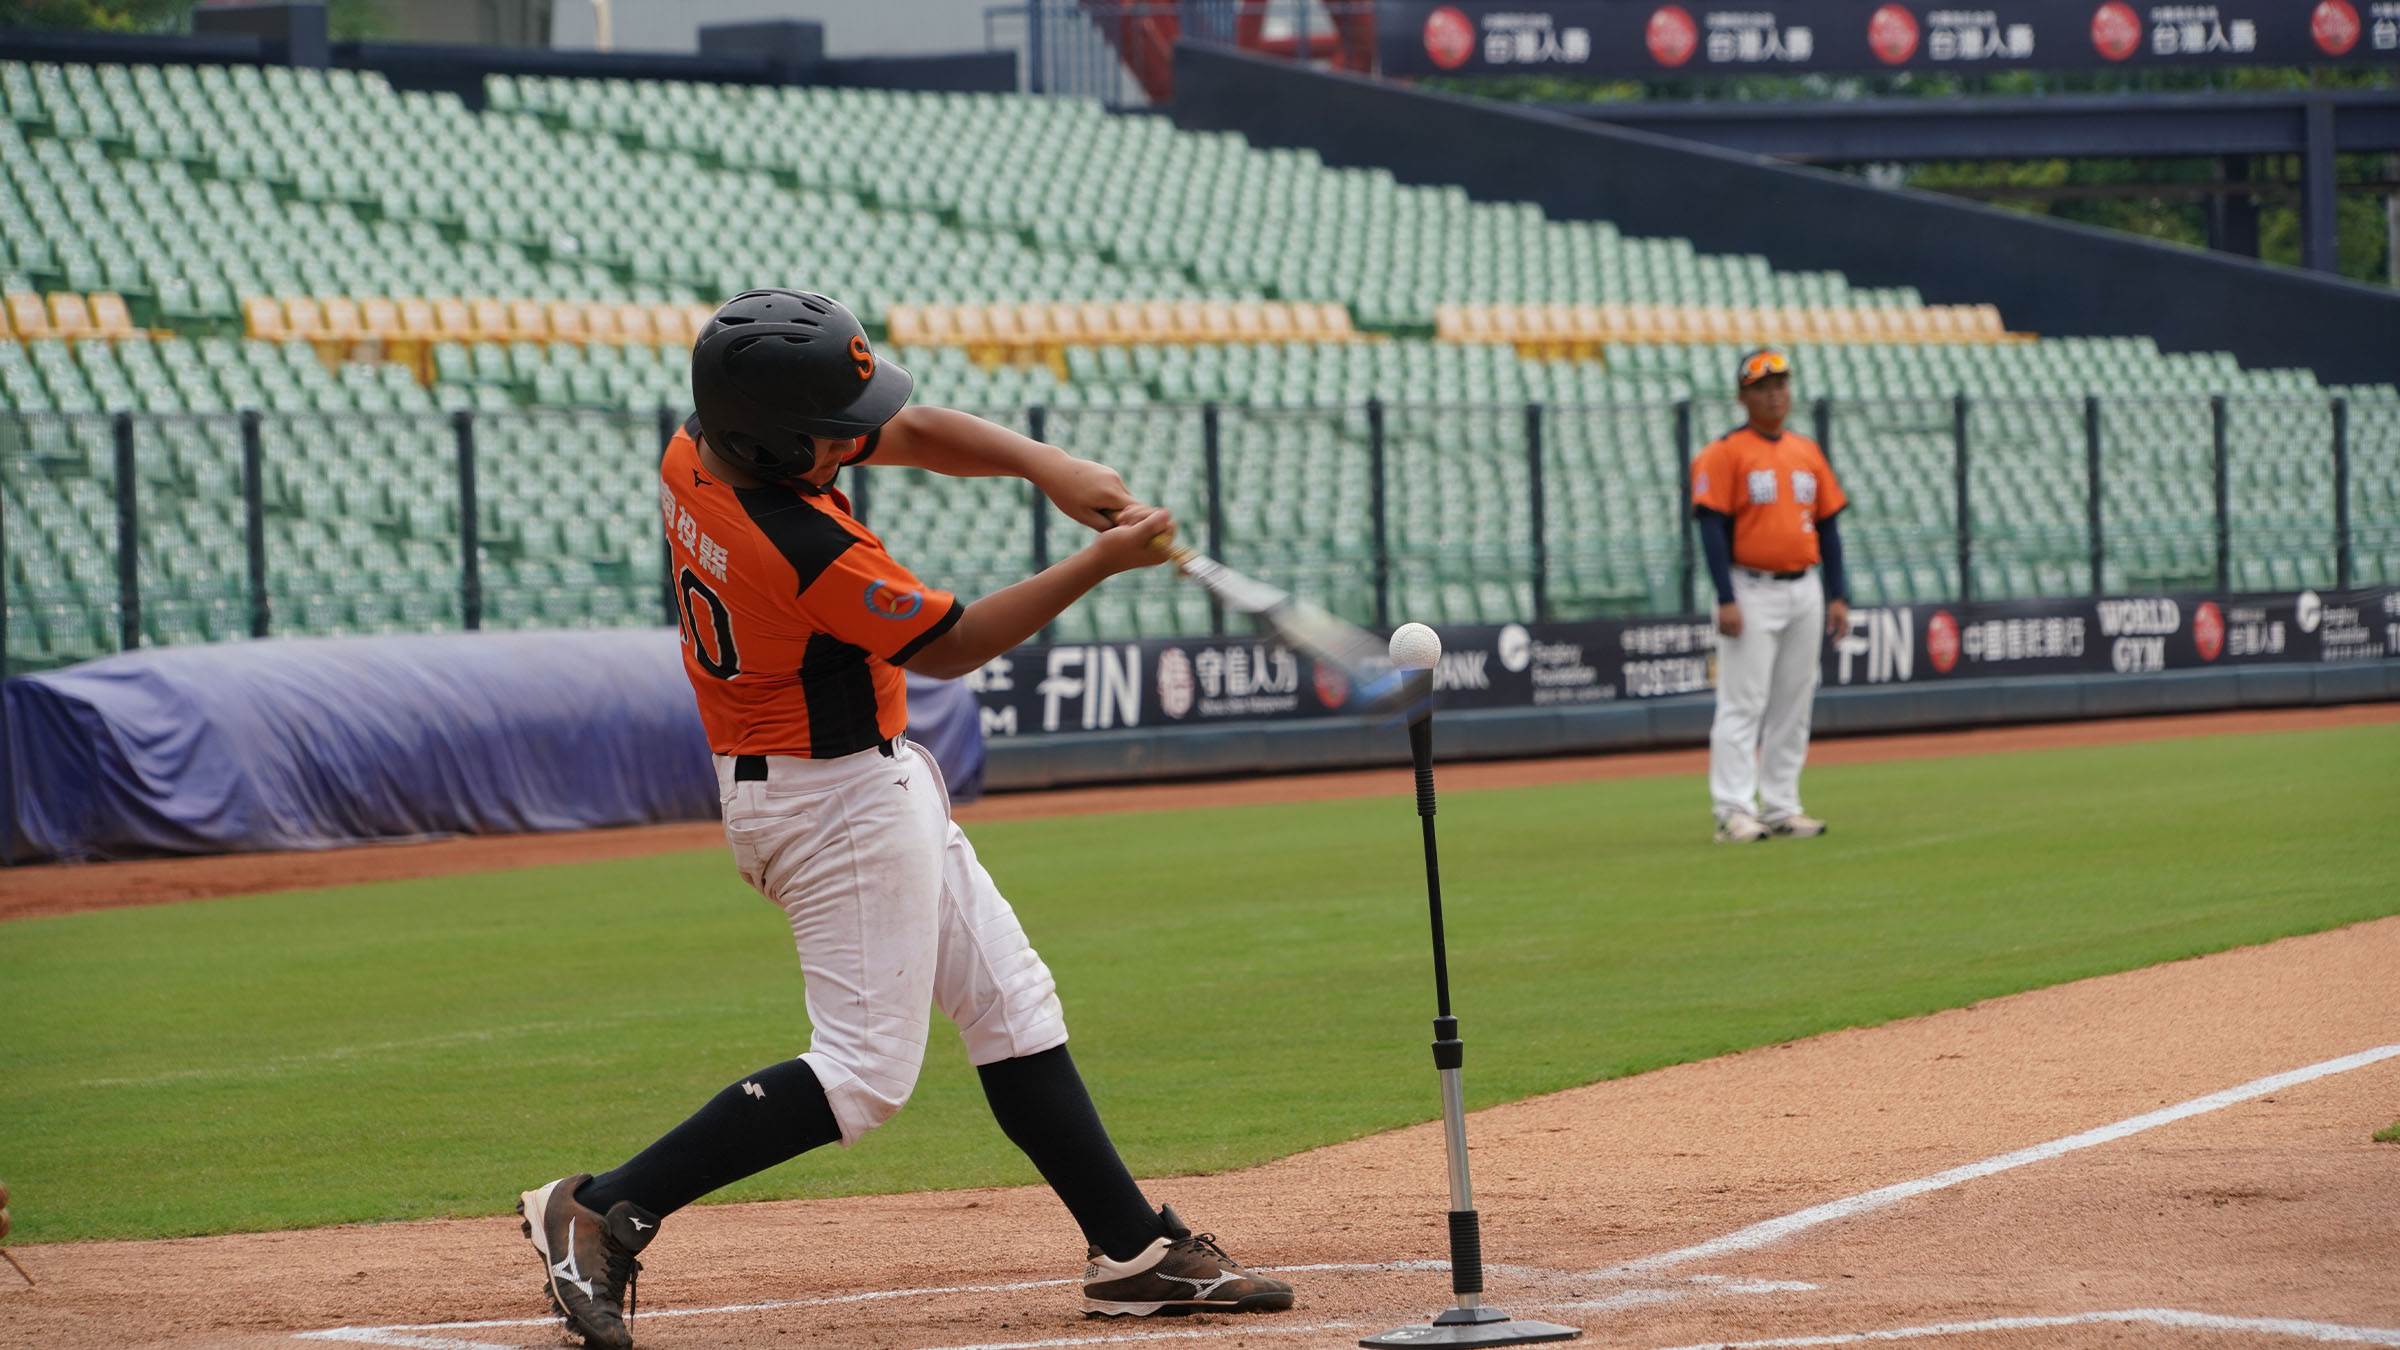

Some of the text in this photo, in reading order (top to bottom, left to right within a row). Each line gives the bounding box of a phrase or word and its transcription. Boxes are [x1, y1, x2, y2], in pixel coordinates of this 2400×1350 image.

[850, 335, 875, 381] S
[2096, 598, 2181, 636] WORLD
[1834, 607, 1914, 684] FIN
[2112, 636, 2166, 673] GYM
[1036, 644, 1142, 732] FIN
